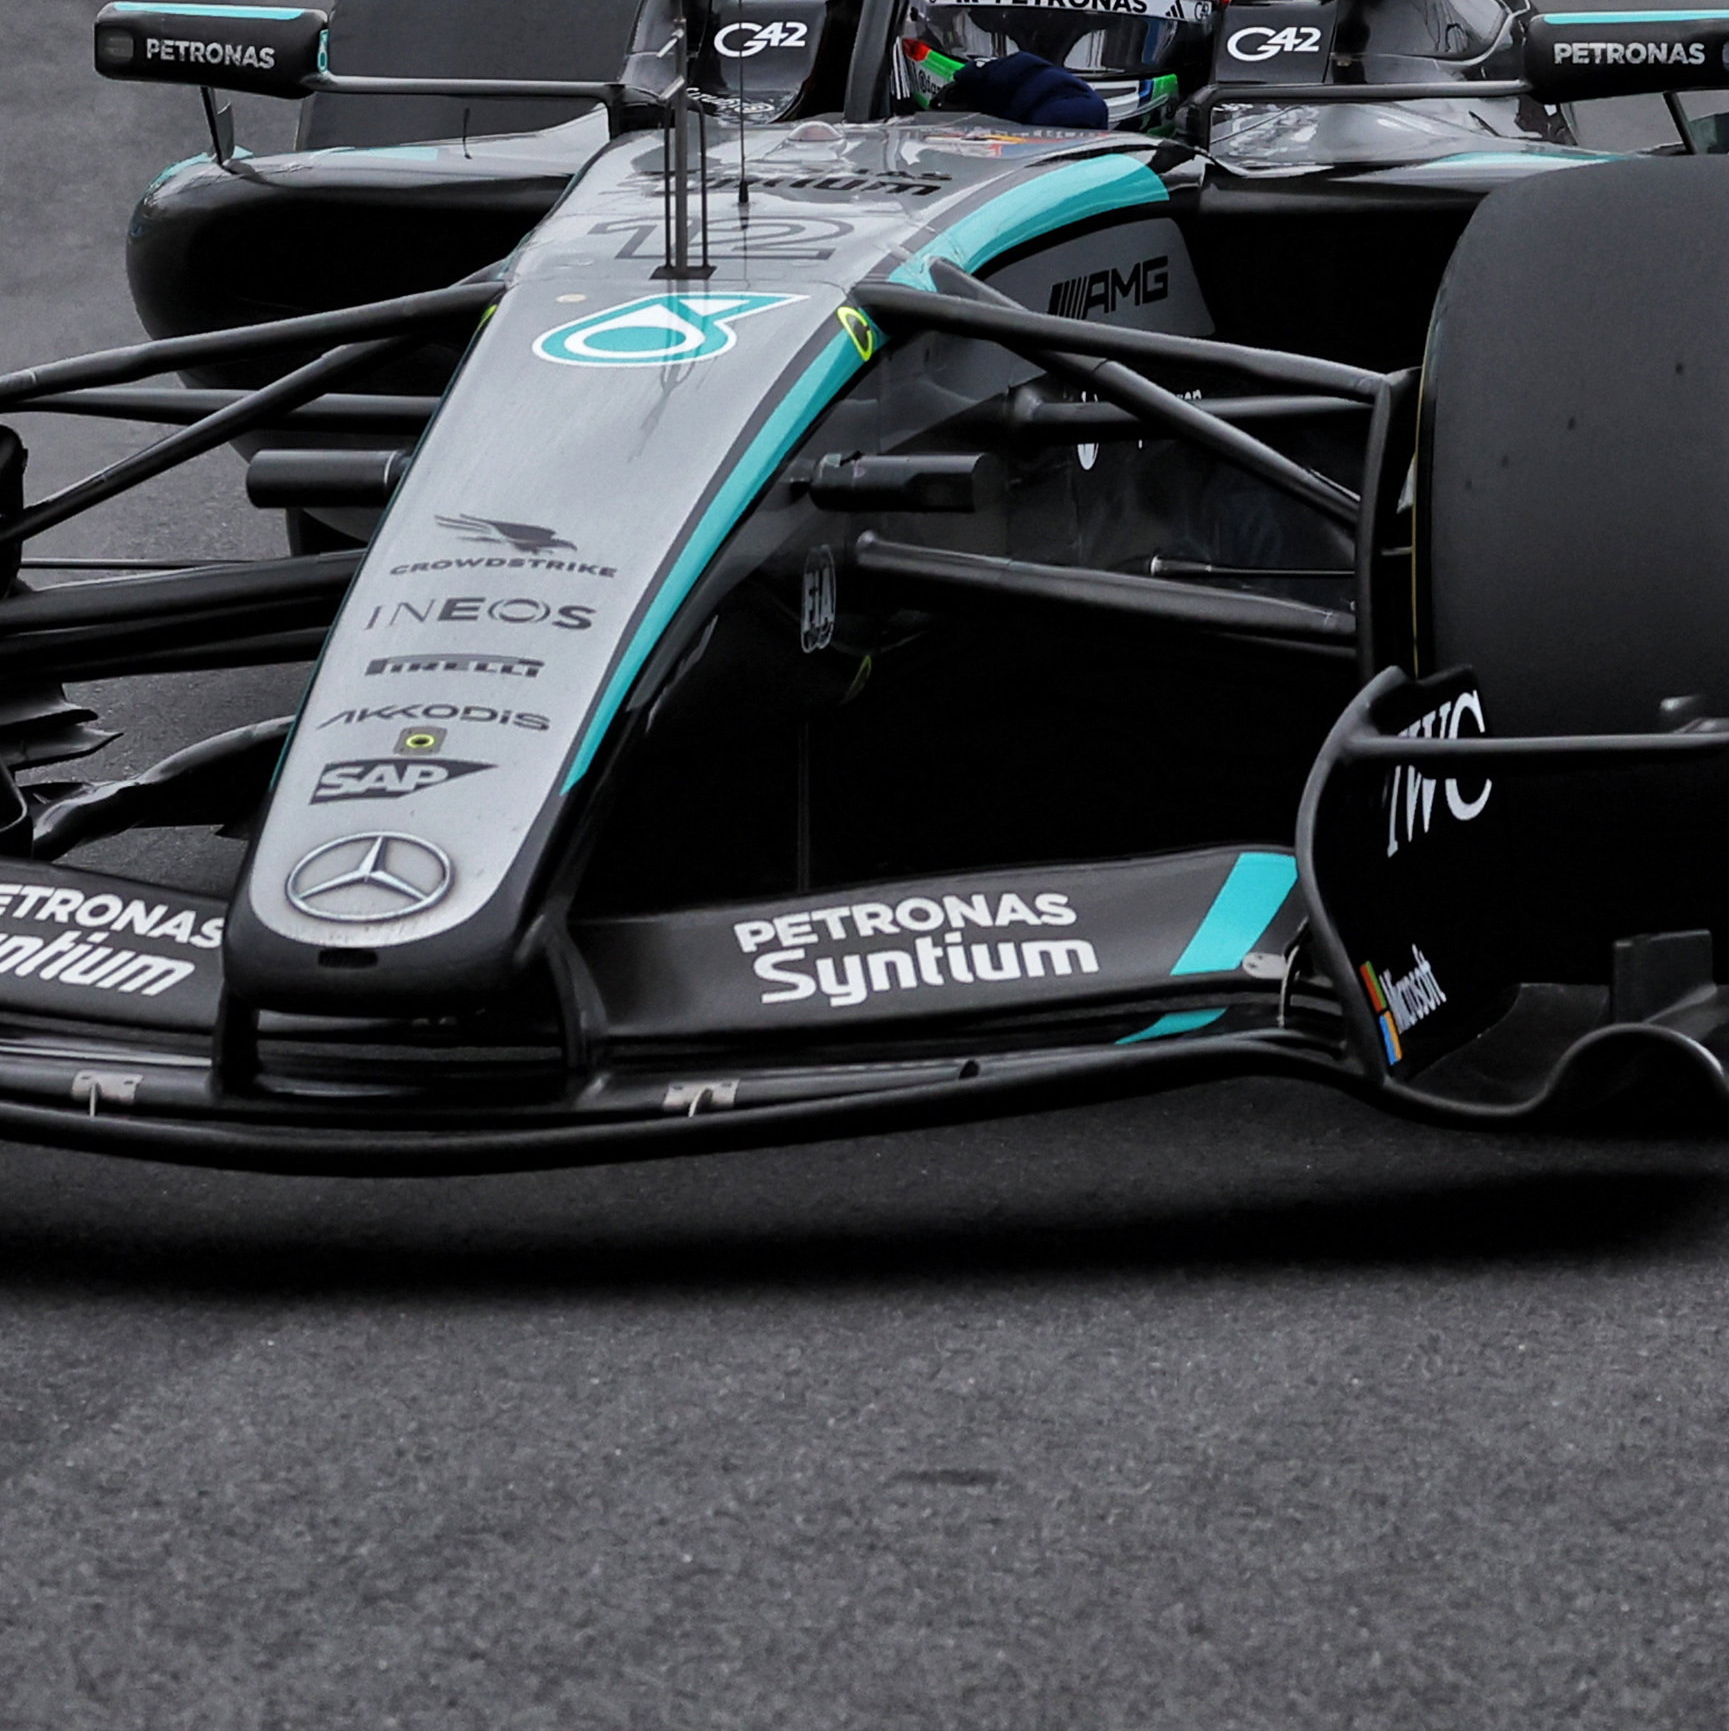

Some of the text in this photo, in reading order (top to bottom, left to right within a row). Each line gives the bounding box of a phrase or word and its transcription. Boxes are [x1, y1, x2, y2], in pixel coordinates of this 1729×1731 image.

[145, 37, 275, 70] PETRONAS
[714, 22, 808, 58] G42
[1227, 26, 1320, 62] G42
[1553, 40, 1706, 66] PETRONAS
[389, 557, 618, 579] CROWDSTRIKE
[364, 596, 597, 631] INEOS
[364, 653, 546, 679] PIRELLI
[315, 762, 450, 796] SAP
[1385, 690, 1493, 858] IWC
[733, 891, 1077, 954] PETRONAS
[752, 931, 1100, 1007] Syntium
